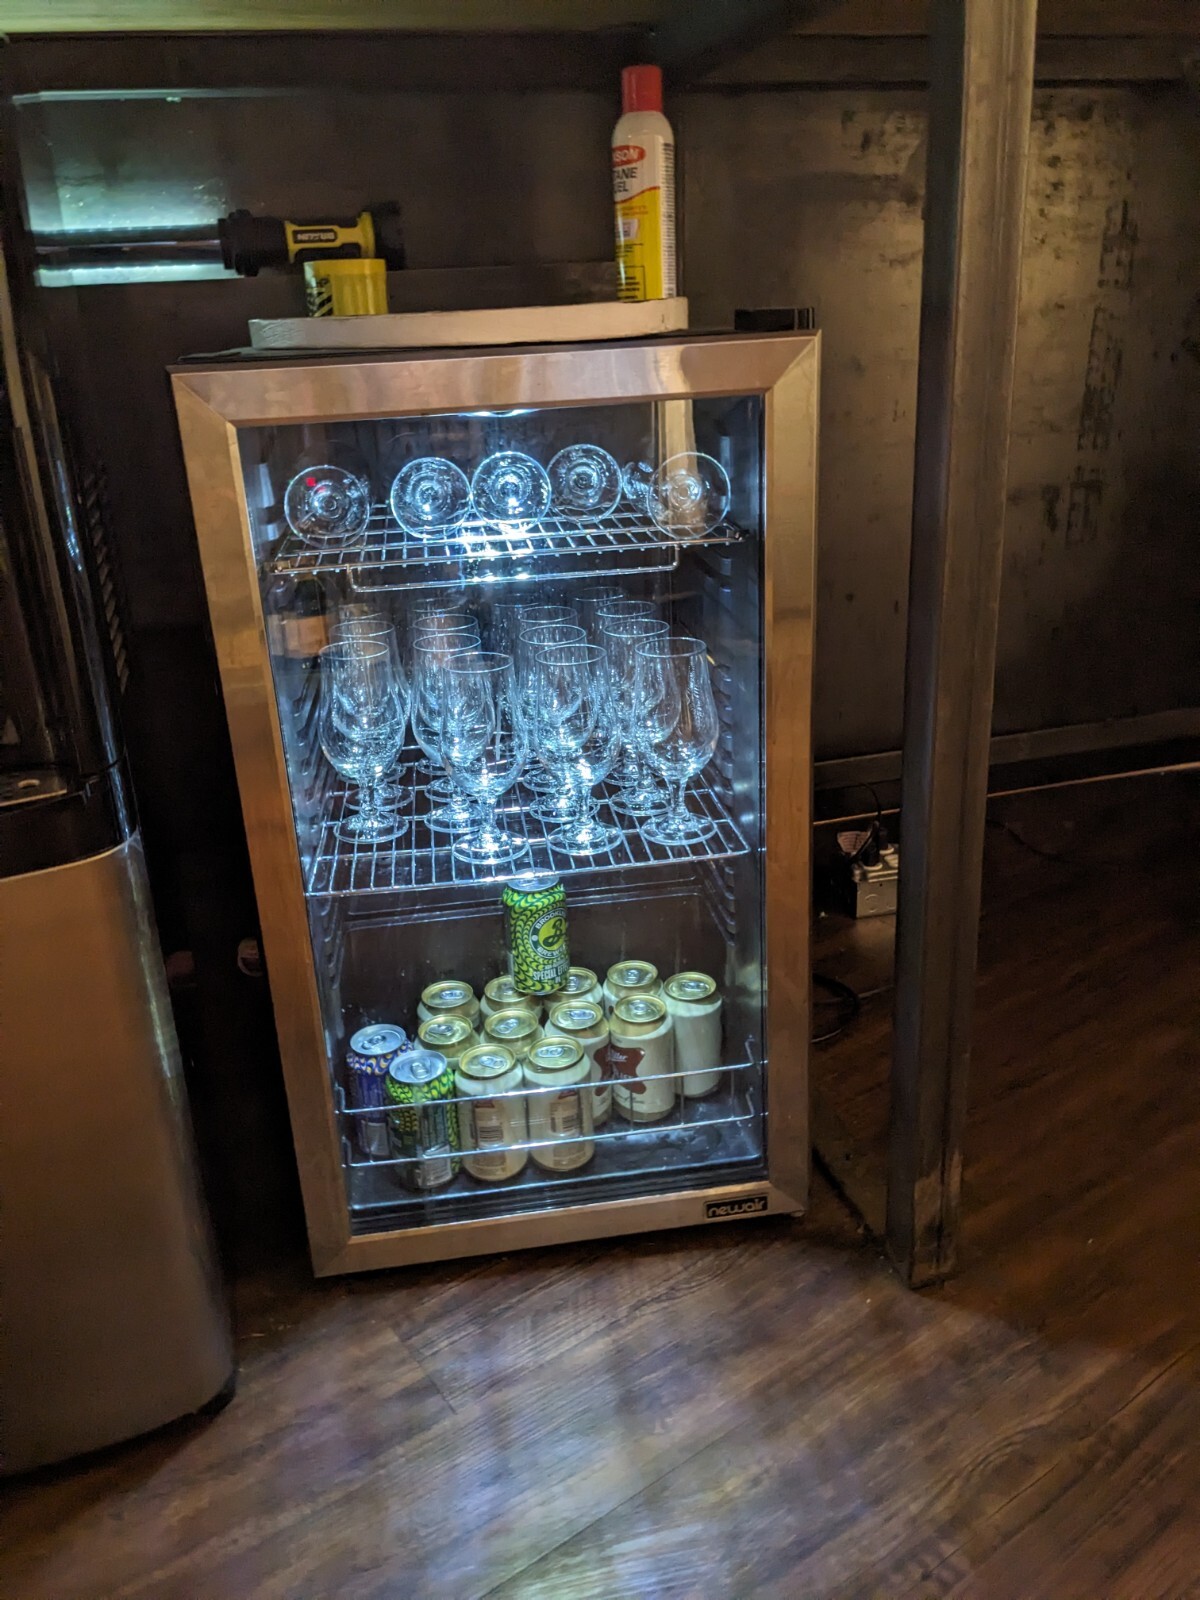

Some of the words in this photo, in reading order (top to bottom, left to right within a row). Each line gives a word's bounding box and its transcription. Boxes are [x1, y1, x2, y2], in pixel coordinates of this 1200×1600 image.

[613, 148, 640, 161] SON
[533, 968, 557, 981] SPECIAL
[708, 1198, 766, 1217] newair
